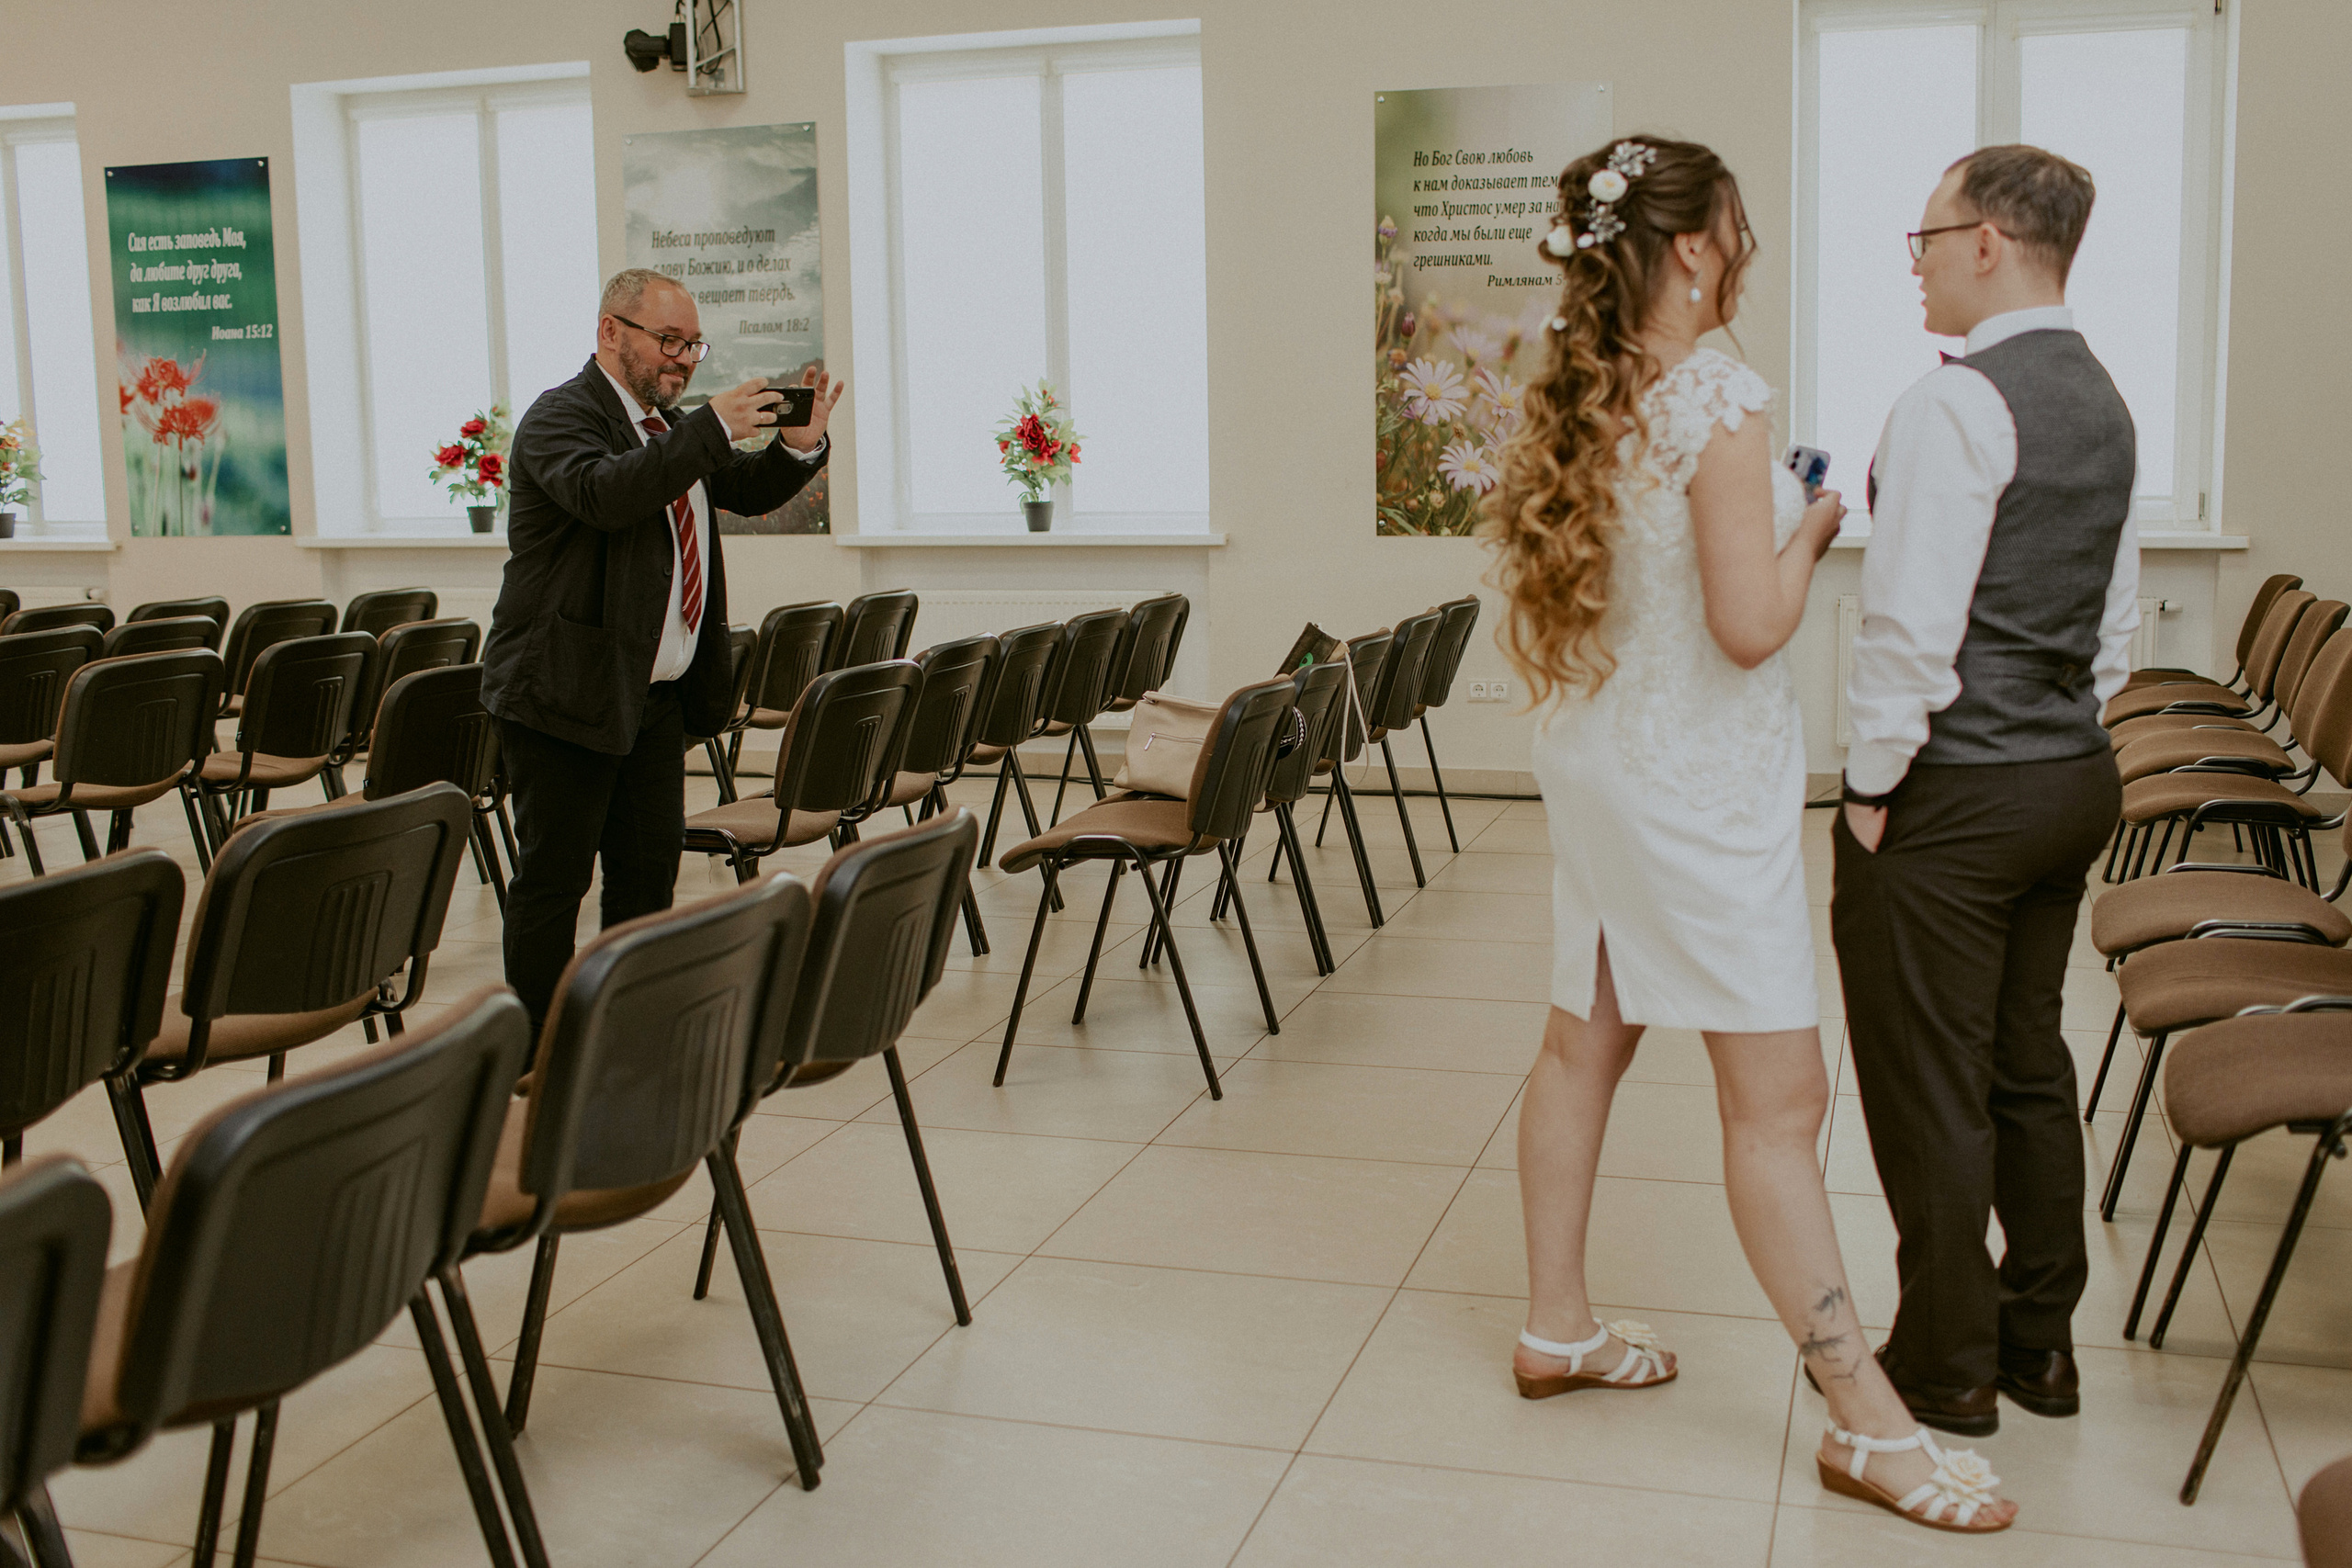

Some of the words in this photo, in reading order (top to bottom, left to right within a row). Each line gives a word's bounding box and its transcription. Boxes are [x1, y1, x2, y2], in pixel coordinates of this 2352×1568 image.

[1414, 151, 1429, 166] Но
[1431, 151, 1453, 166] Бог
[1455, 150, 1485, 164] Свою
[1487, 148, 1533, 164] любовь
[1414, 180, 1421, 191] к
[1423, 178, 1448, 191] нам
[1451, 175, 1528, 190] доказывает
[1414, 205, 1438, 217] что
[1442, 201, 1492, 220] Христос
[1494, 201, 1525, 219] умер
[1528, 201, 1542, 214] за
[129, 232, 147, 252] Сия
[148, 233, 173, 250] есть
[175, 228, 221, 249] заповедь
[222, 227, 246, 249] Моя,
[651, 231, 691, 249] Небеса
[694, 225, 775, 250] проповедуют
[1414, 226, 1447, 242] когда
[1450, 229, 1470, 241] мы
[1474, 225, 1505, 240] были
[1509, 227, 1532, 243] еще
[688, 258, 734, 276] Божию,
[738, 262, 744, 274] и
[747, 261, 753, 273] о
[757, 254, 791, 273] делах
[1414, 254, 1493, 271] грешниками.
[130, 263, 142, 282] да
[144, 261, 185, 282] любите
[187, 260, 209, 285] друг
[210, 259, 242, 284] друга,
[1487, 275, 1553, 287] Римлянам
[132, 297, 152, 312] как
[153, 293, 160, 312] Я
[162, 290, 210, 311] возлюбил
[212, 293, 232, 310] вас.
[698, 288, 745, 307] вещает
[749, 283, 796, 306] твердь.
[245, 324, 273, 339] 15:12
[739, 321, 783, 334] Псалом
[786, 318, 809, 333] 18:2
